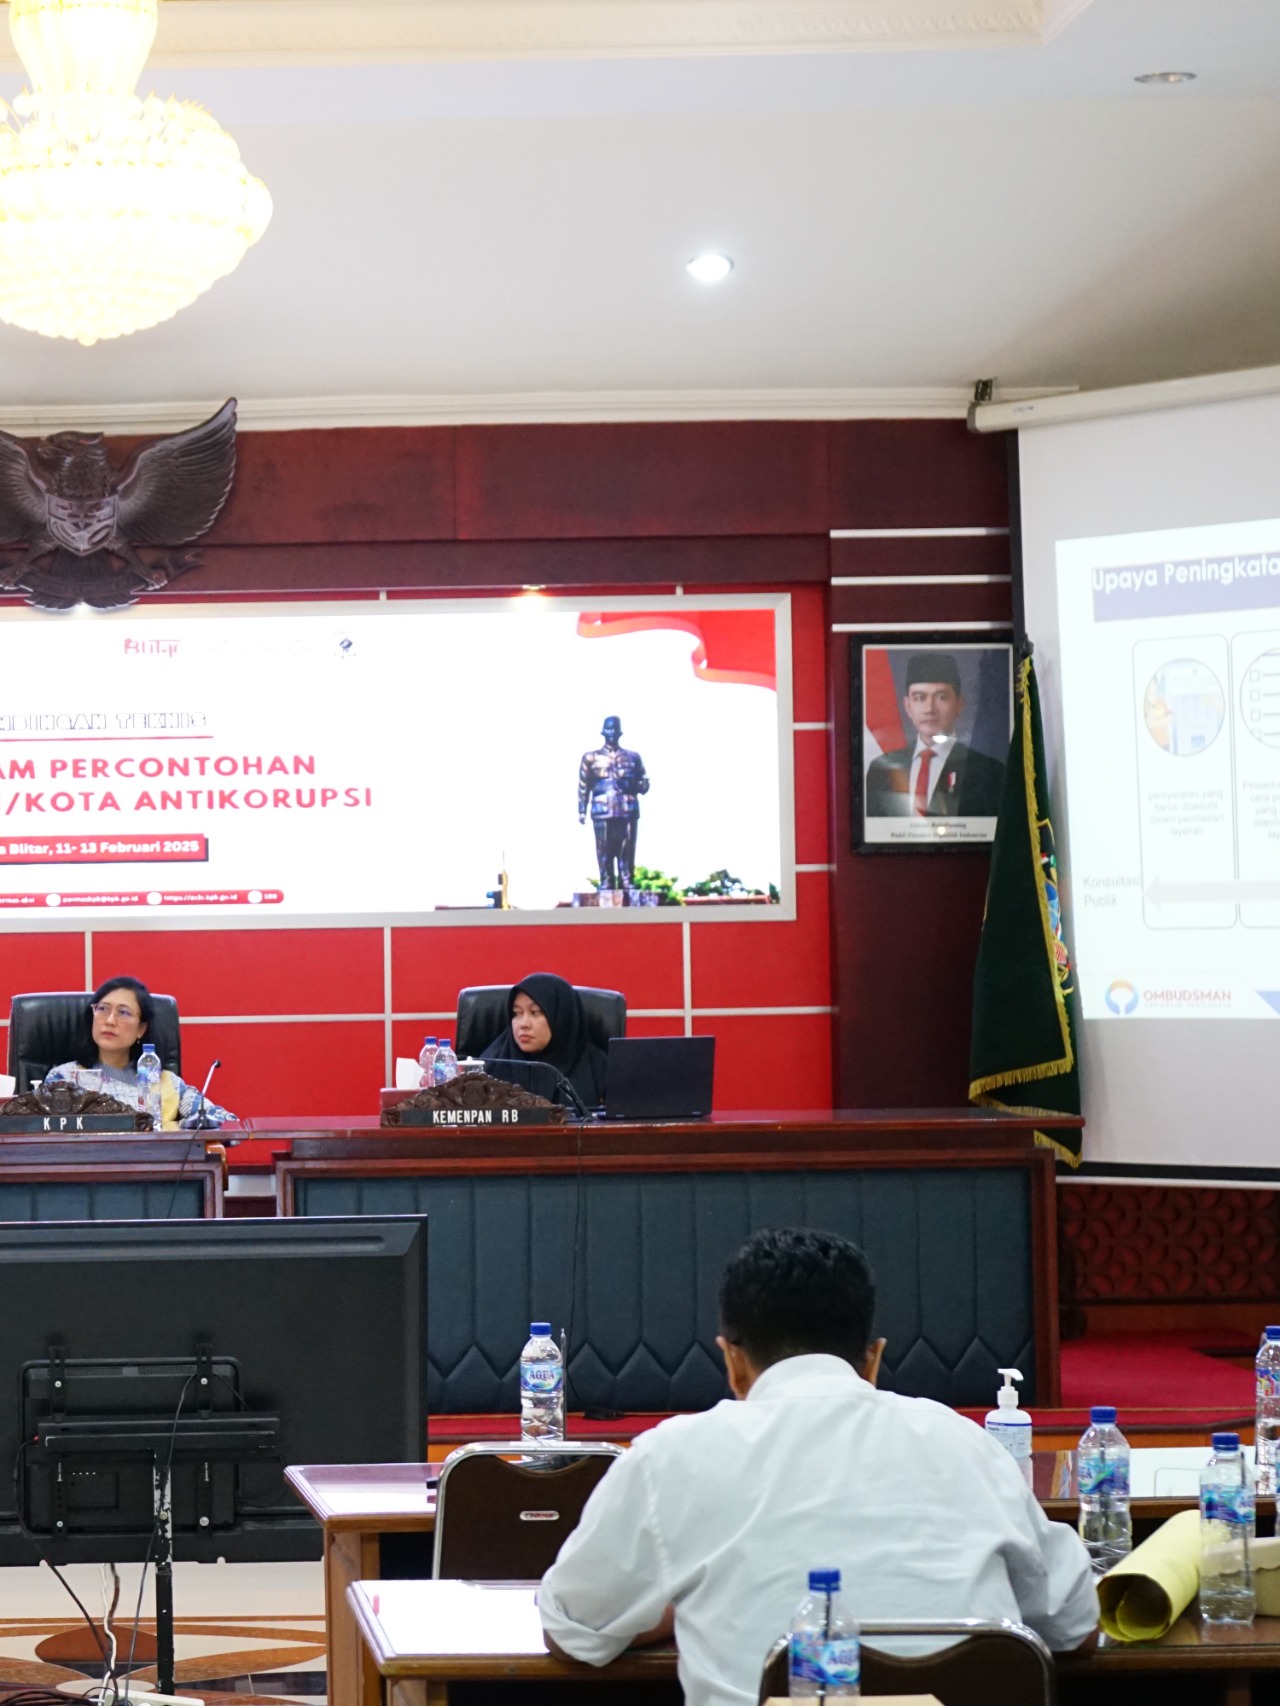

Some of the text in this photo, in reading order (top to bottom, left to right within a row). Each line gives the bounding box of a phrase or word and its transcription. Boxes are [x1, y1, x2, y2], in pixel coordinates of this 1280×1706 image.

[1092, 568, 1158, 595] Upaya
[115, 711, 207, 729] TEKNIS
[50, 755, 315, 779] PERCONTOHAN
[133, 787, 372, 811] ANTIKORUPSI
[9, 843, 54, 857] Blitar,
[80, 842, 97, 855] 13
[100, 840, 161, 854] Februari
[163, 840, 200, 853] 2025
[1083, 874, 1142, 889] Konsultasi
[1084, 893, 1119, 907] Publik
[1143, 989, 1232, 1002] OMBUDSMAN
[432, 1108, 519, 1124] KEMENPAN RB
[529, 1369, 555, 1382] AQUA
